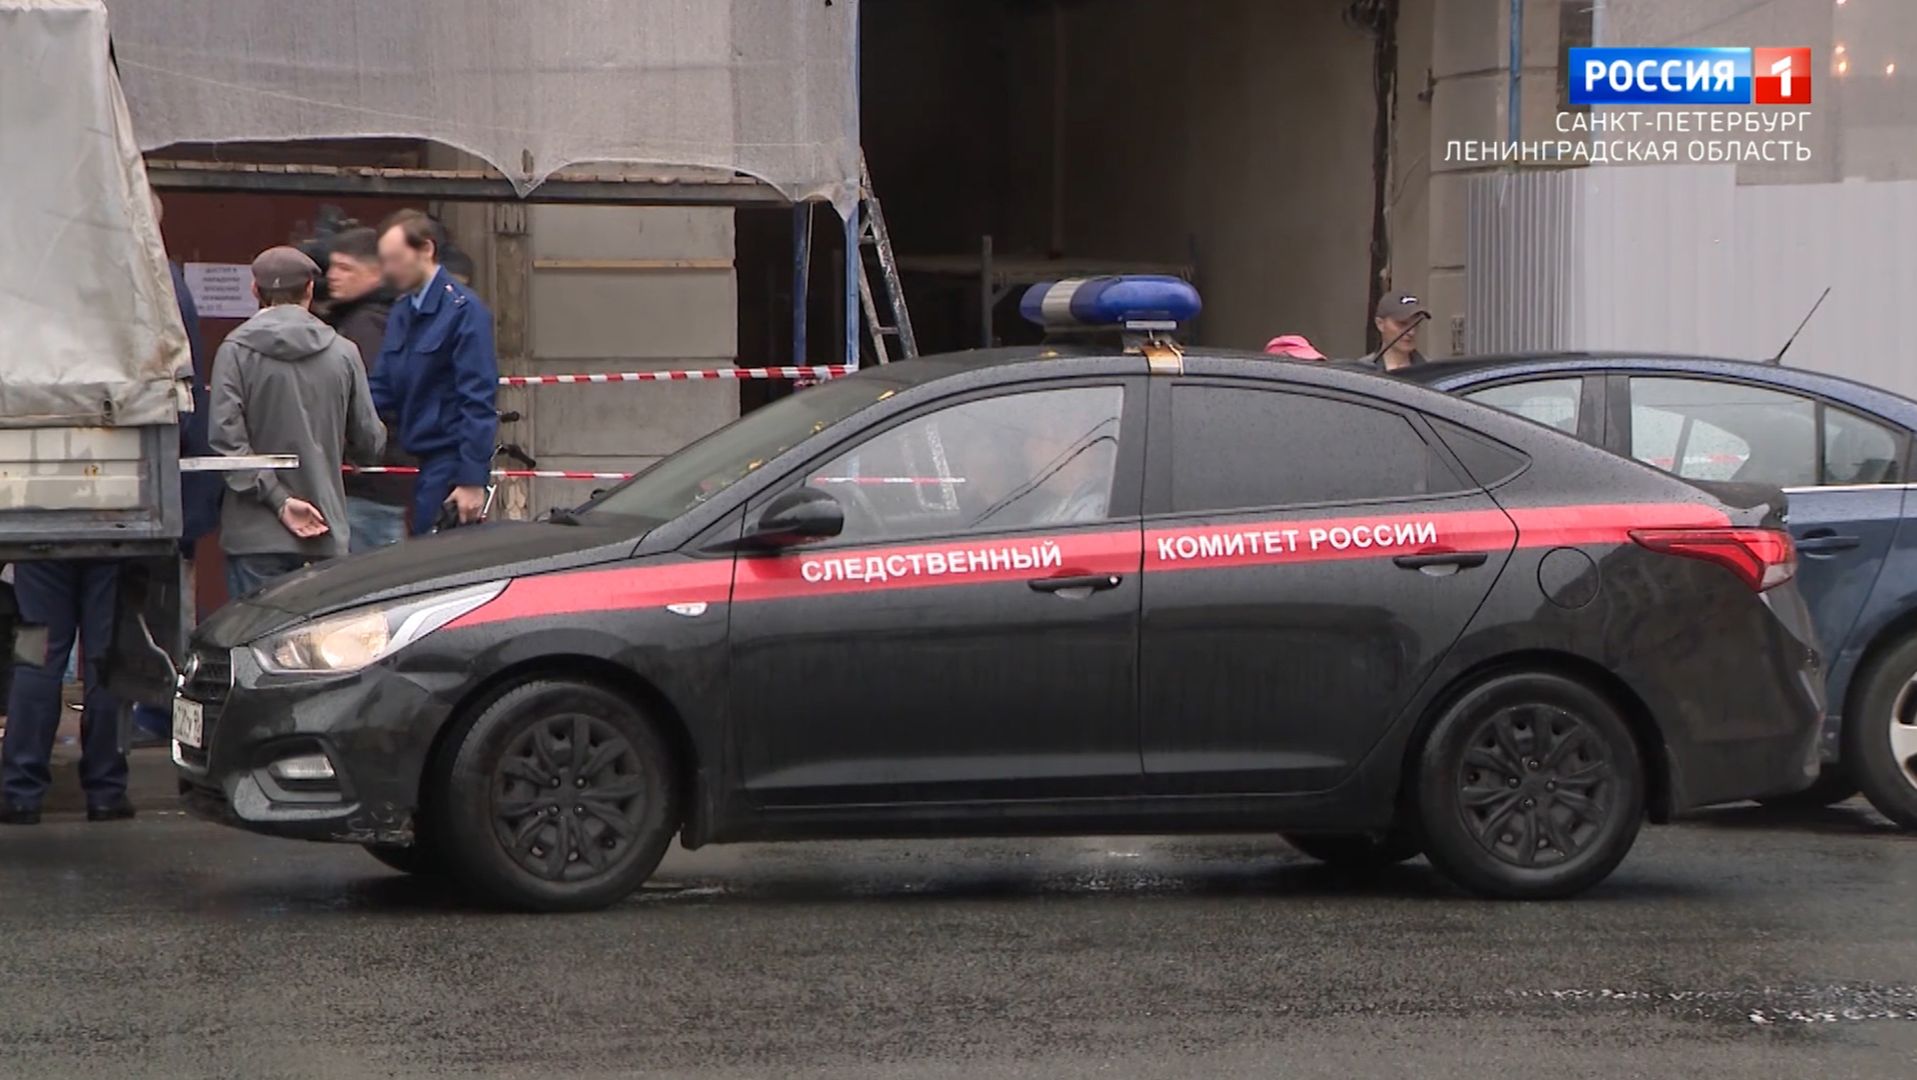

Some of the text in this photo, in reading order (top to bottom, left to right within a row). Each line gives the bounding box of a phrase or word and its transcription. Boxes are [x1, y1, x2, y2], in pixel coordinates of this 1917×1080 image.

[800, 520, 1438, 583] СЛЕДСТВЕННЫЙ КОМИТЕТ РОССИИ
